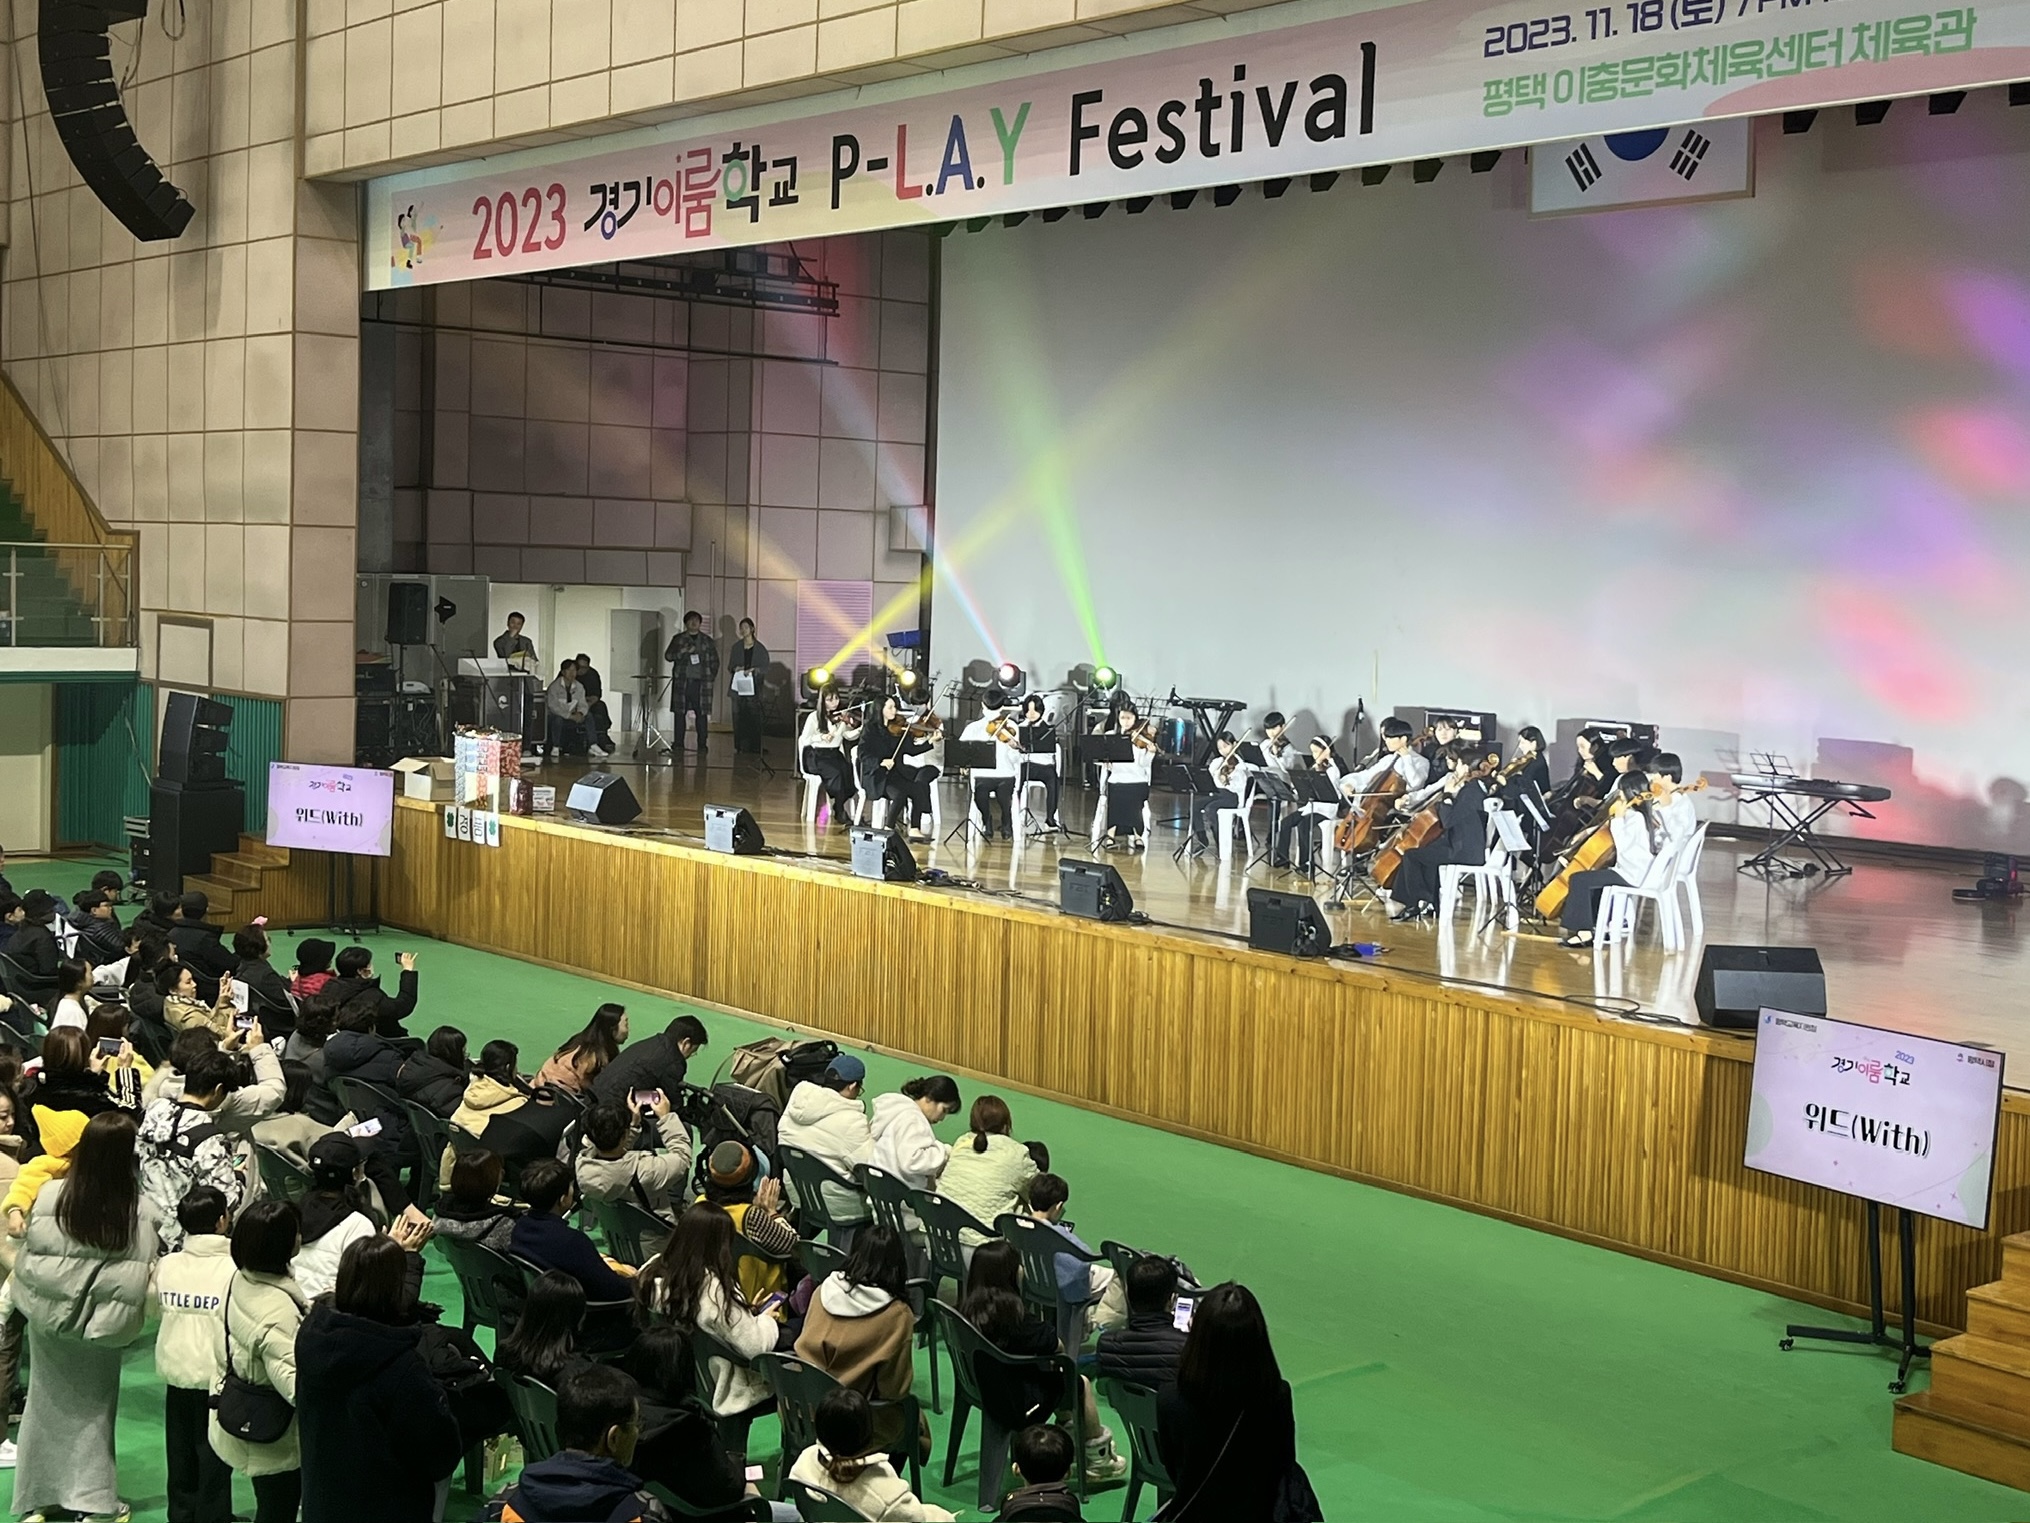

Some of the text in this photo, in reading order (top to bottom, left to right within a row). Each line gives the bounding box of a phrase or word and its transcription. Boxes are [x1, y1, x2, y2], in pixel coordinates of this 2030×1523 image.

[1482, 7, 1978, 117] 평택 이충문화체육센터 체육관
[471, 40, 1377, 260] 2023 경기이룸학교 P-L.A.Y Festival
[295, 807, 363, 828] 위드(With)
[1830, 1056, 1911, 1086] 경기이룸학교
[1894, 1050, 1915, 1065] 2023
[1804, 1102, 1930, 1157] 위드(With)
[159, 1291, 191, 1308] ITTLE
